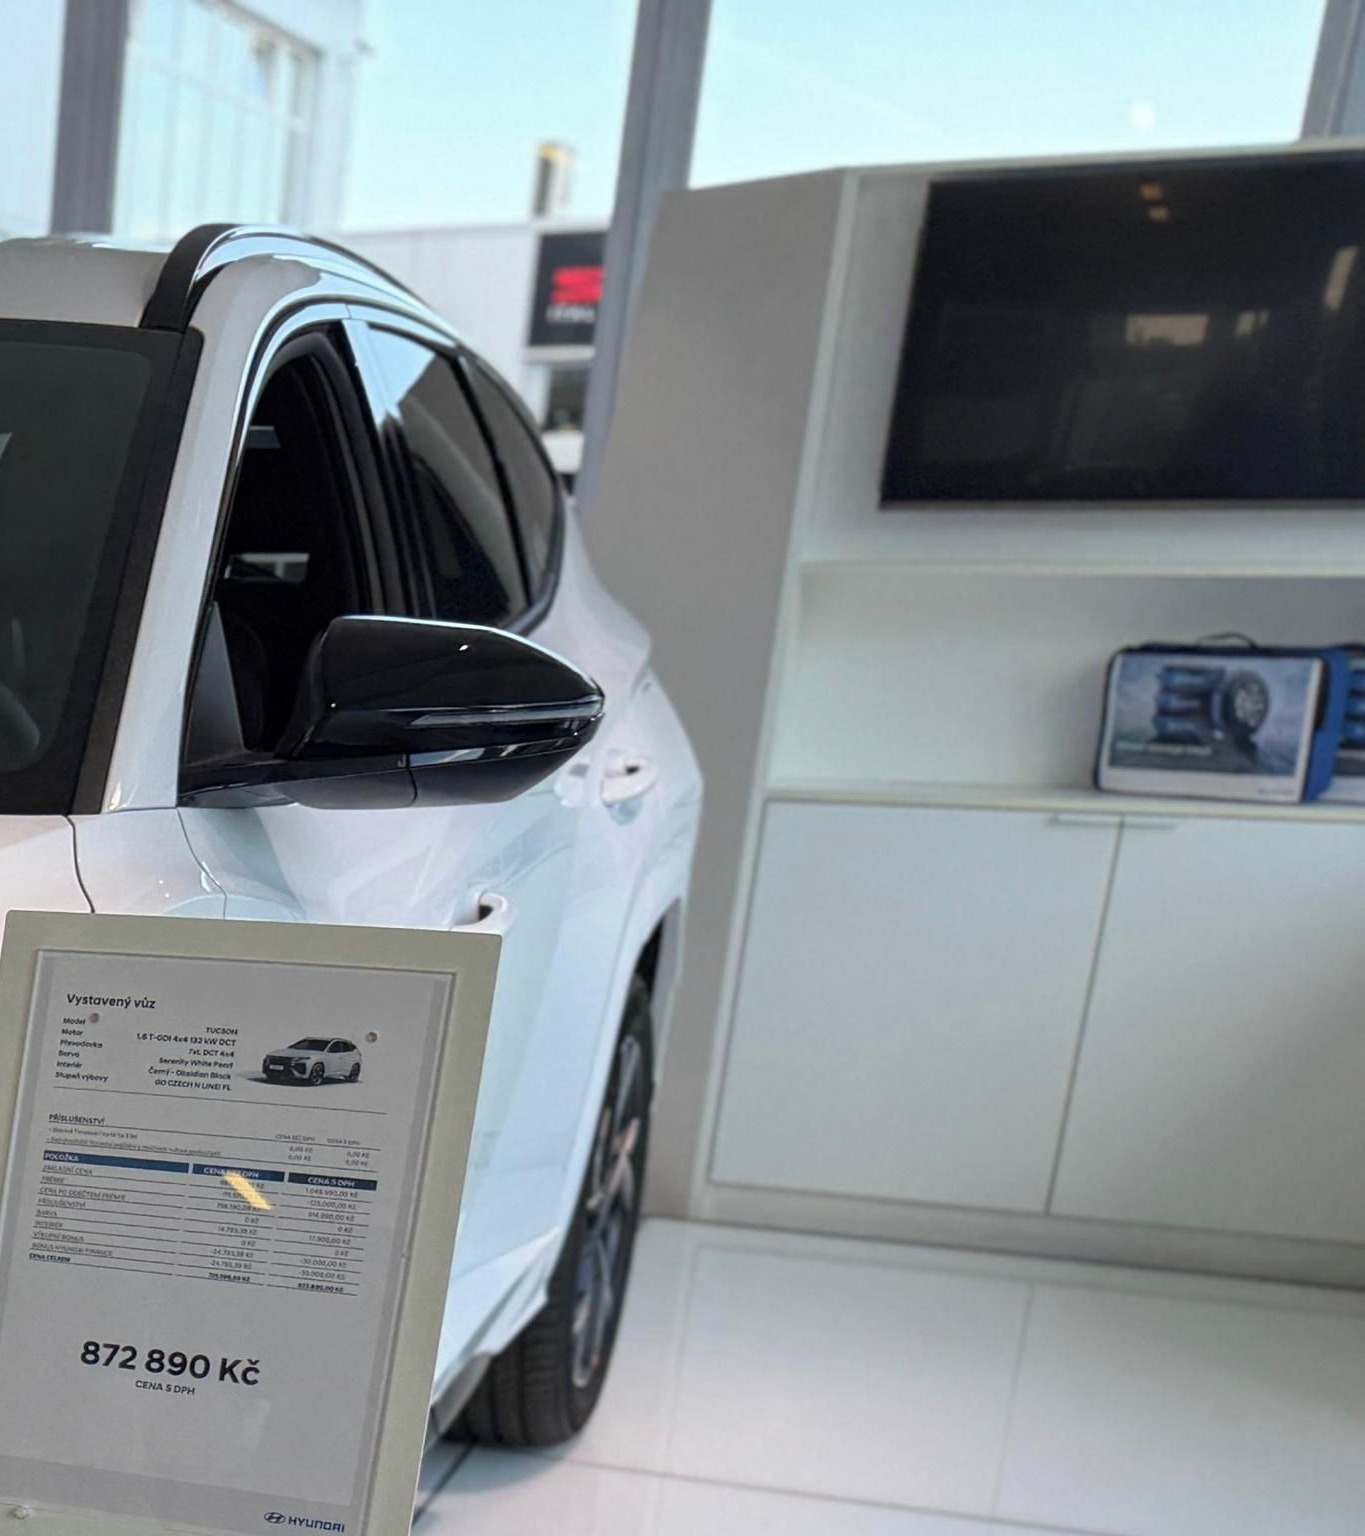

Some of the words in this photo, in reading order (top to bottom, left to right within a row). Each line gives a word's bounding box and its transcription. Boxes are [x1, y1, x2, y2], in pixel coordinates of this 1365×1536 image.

[67, 993, 131, 1009] Vystavený
[134, 996, 156, 1009] vůz
[63, 1017, 86, 1025] Model
[61, 1028, 83, 1036] Motor
[206, 1027, 238, 1036] TUCSON
[173, 1035, 189, 1043] 4x4
[203, 1037, 218, 1046] kW
[219, 1038, 237, 1047] DCT
[58, 1050, 80, 1058] Barva
[203, 1049, 219, 1057] DCT
[80, 1340, 138, 1370] 872
[145, 1348, 210, 1379] 890
[218, 1357, 260, 1386] Kč
[135, 1380, 163, 1392] CENA
[165, 1383, 172, 1393] S
[173, 1384, 195, 1396] DPH
[288, 1516, 345, 1533] HYUNDAI
